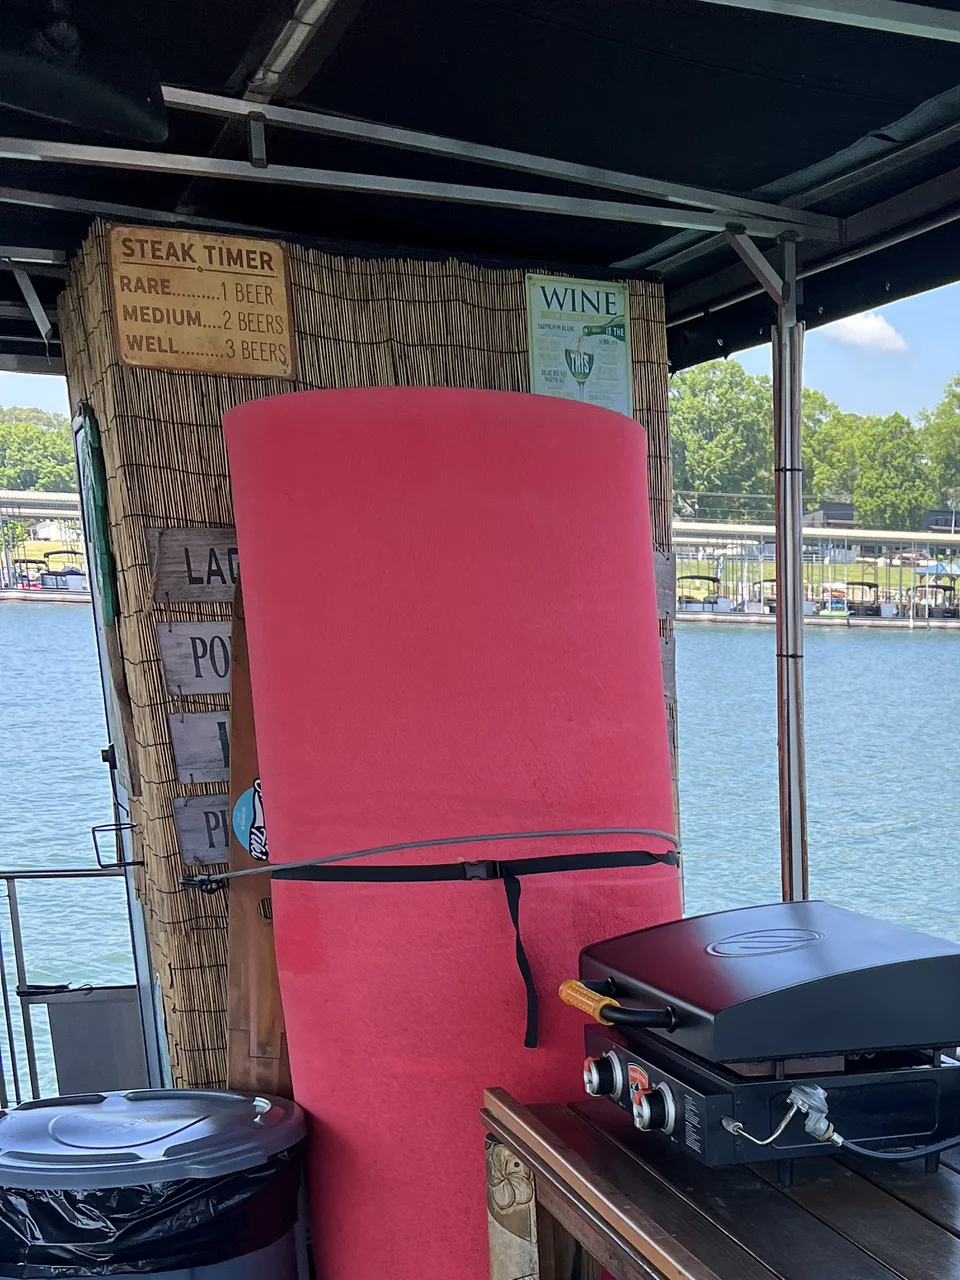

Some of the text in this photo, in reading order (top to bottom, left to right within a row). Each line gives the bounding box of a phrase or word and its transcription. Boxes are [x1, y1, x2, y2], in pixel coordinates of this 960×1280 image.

[121, 237, 275, 271] STEAK TIMER
[119, 275, 171, 296] RARE
[235, 283, 274, 305] BEER
[540, 286, 618, 316] WINE
[122, 305, 285, 335] MEDIUM 2 BEERS
[605, 326, 625, 337] IS THE
[126, 334, 287, 364] WELL 3 BEERS
[570, 353, 590, 374] THIS
[189, 635, 232, 678] PO
